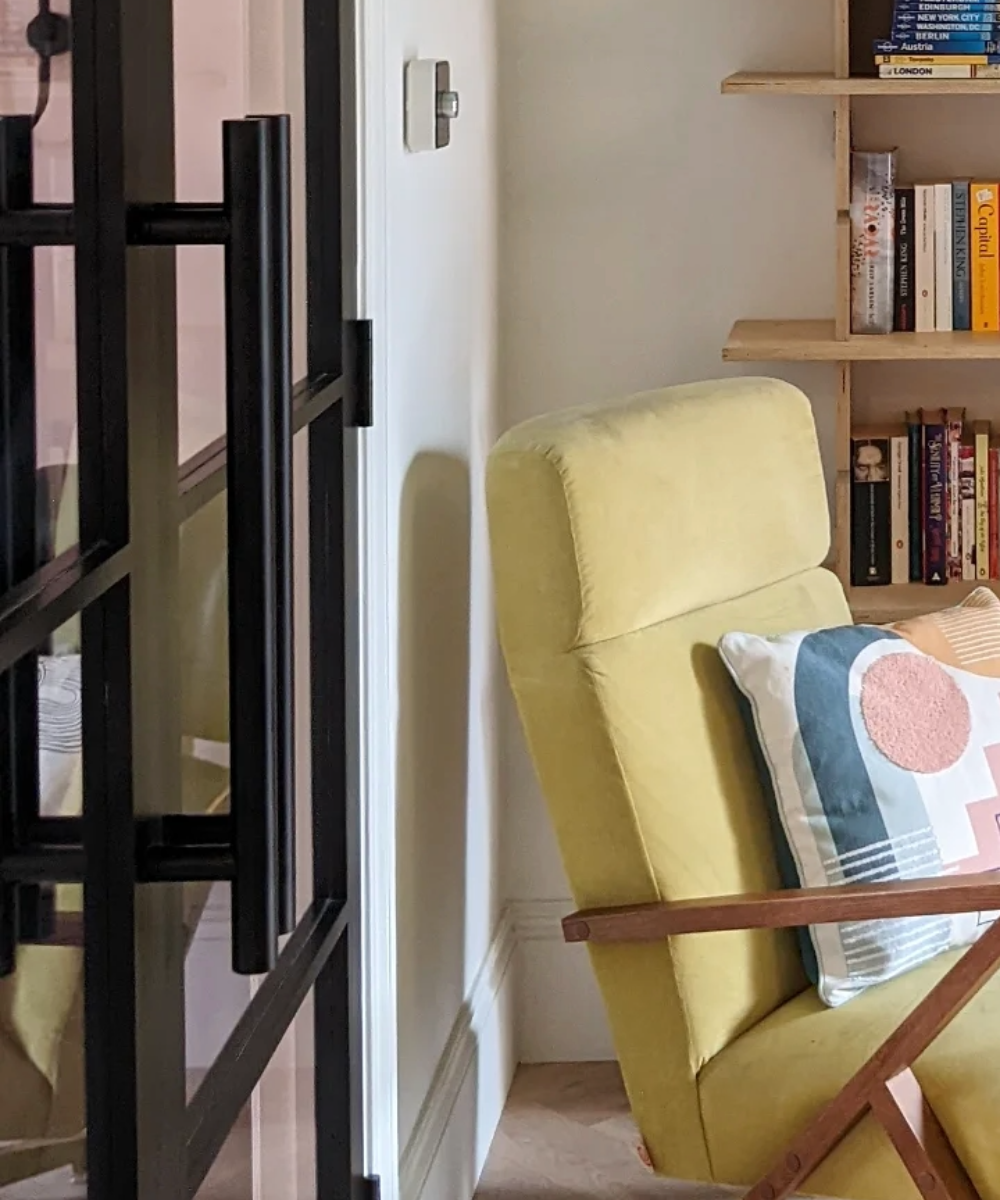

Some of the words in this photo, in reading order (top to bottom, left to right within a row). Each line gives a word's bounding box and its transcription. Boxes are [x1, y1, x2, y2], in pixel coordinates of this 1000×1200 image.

[917, 13, 937, 22] NEW
[937, 13, 960, 22] YORK
[961, 13, 980, 22] CITY
[900, 42, 934, 51] Austria
[915, 32, 950, 41] BERLIN
[894, 67, 933, 75] LONDON
[955, 193, 966, 246] STEPHEN
[974, 203, 995, 258] Capital
[900, 242, 908, 263] KING
[955, 248, 967, 277] KING
[900, 264, 908, 297] STEPHEN
